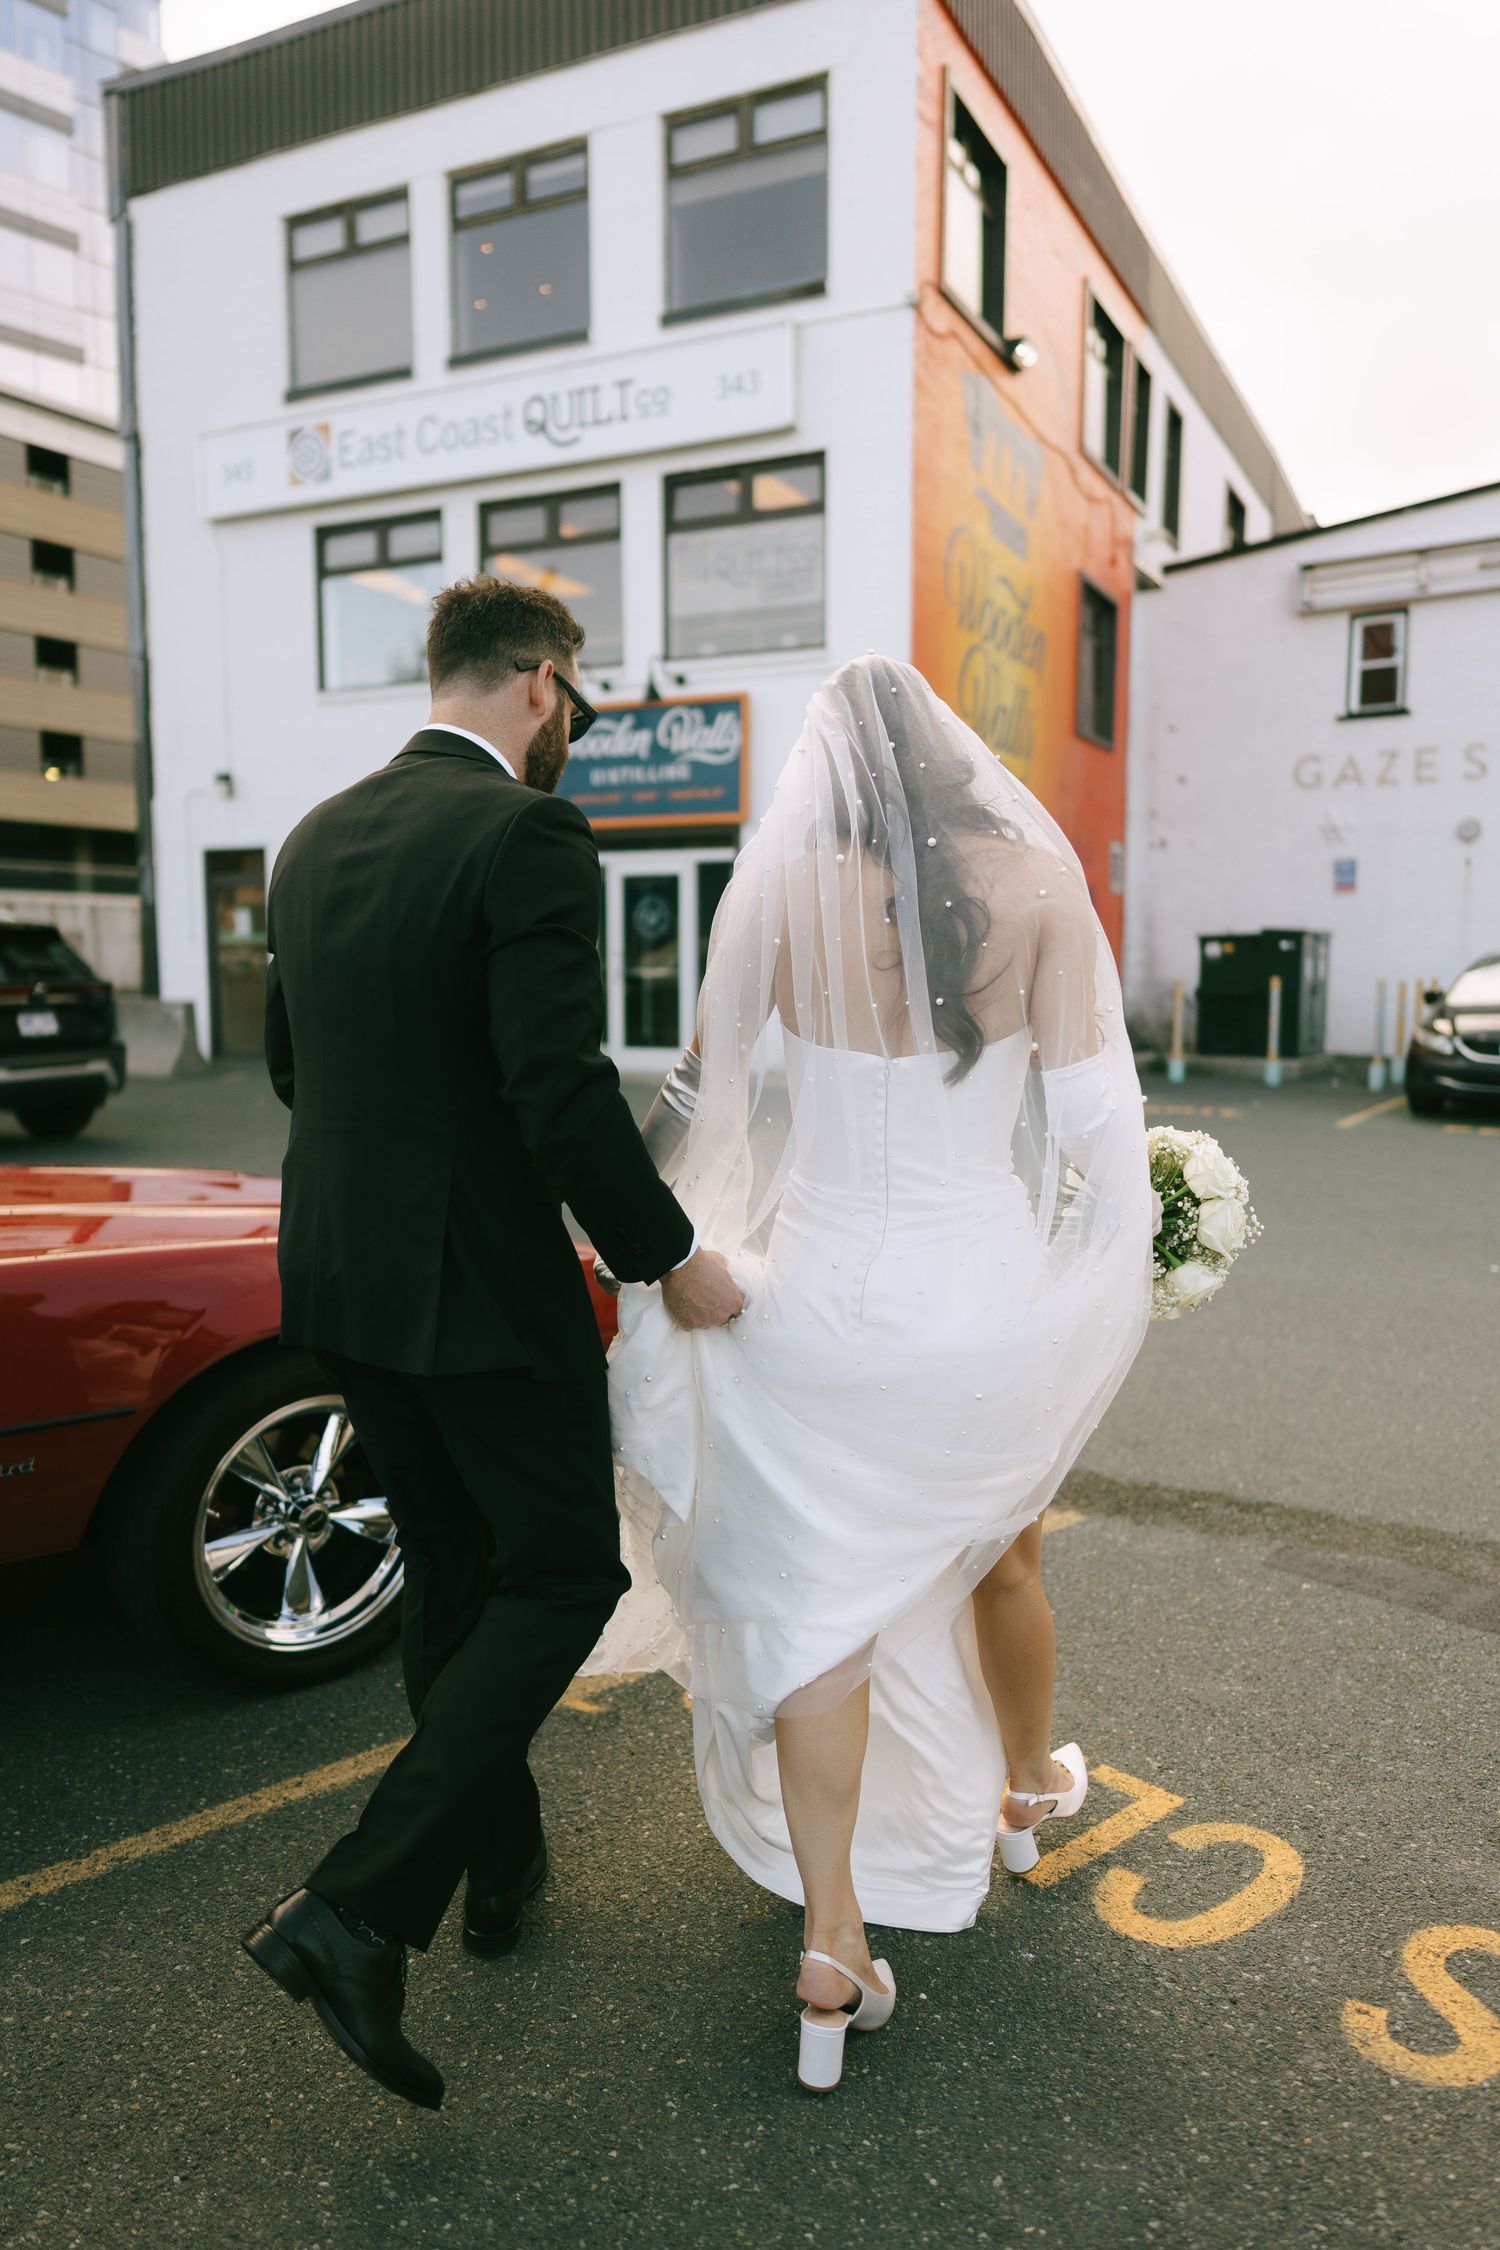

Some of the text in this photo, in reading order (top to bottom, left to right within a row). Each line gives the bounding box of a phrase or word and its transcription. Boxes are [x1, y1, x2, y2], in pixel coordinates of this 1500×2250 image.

[717, 368, 760, 400] 343
[337, 423, 406, 469] East
[416, 401, 514, 455] Coast
[523, 378, 635, 447] QUILT
[1291, 741, 1489, 790] GAZES
